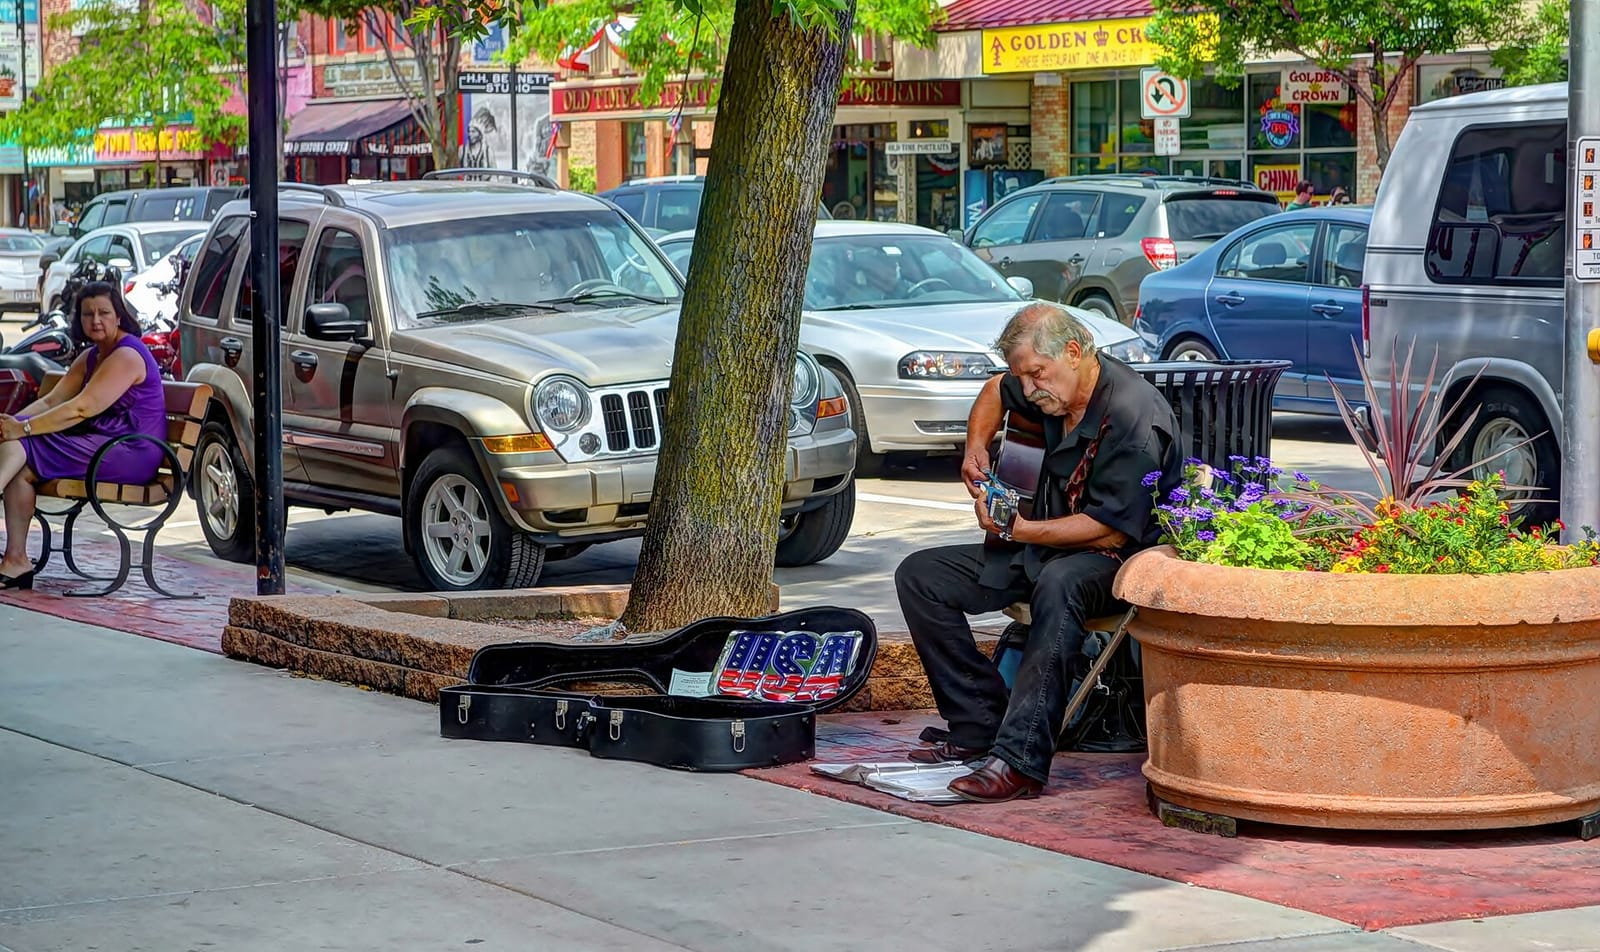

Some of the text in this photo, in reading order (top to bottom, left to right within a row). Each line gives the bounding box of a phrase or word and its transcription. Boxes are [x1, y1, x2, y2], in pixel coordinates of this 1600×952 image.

[1010, 31, 1087, 51] GOLDEN
[1041, 52, 1080, 66] RESTAURANT
[1086, 51, 1100, 65] DINE
[466, 73, 549, 84] H.H. BENETT
[1289, 70, 1341, 83] GOLDEN
[485, 83, 531, 93] STUIO
[848, 79, 944, 102] PORTRAITS
[1292, 90, 1340, 102] CROWN
[563, 89, 591, 111] OLD
[593, 86, 630, 110] TIME
[1257, 169, 1299, 191] CHINA
[716, 632, 860, 703] USA
